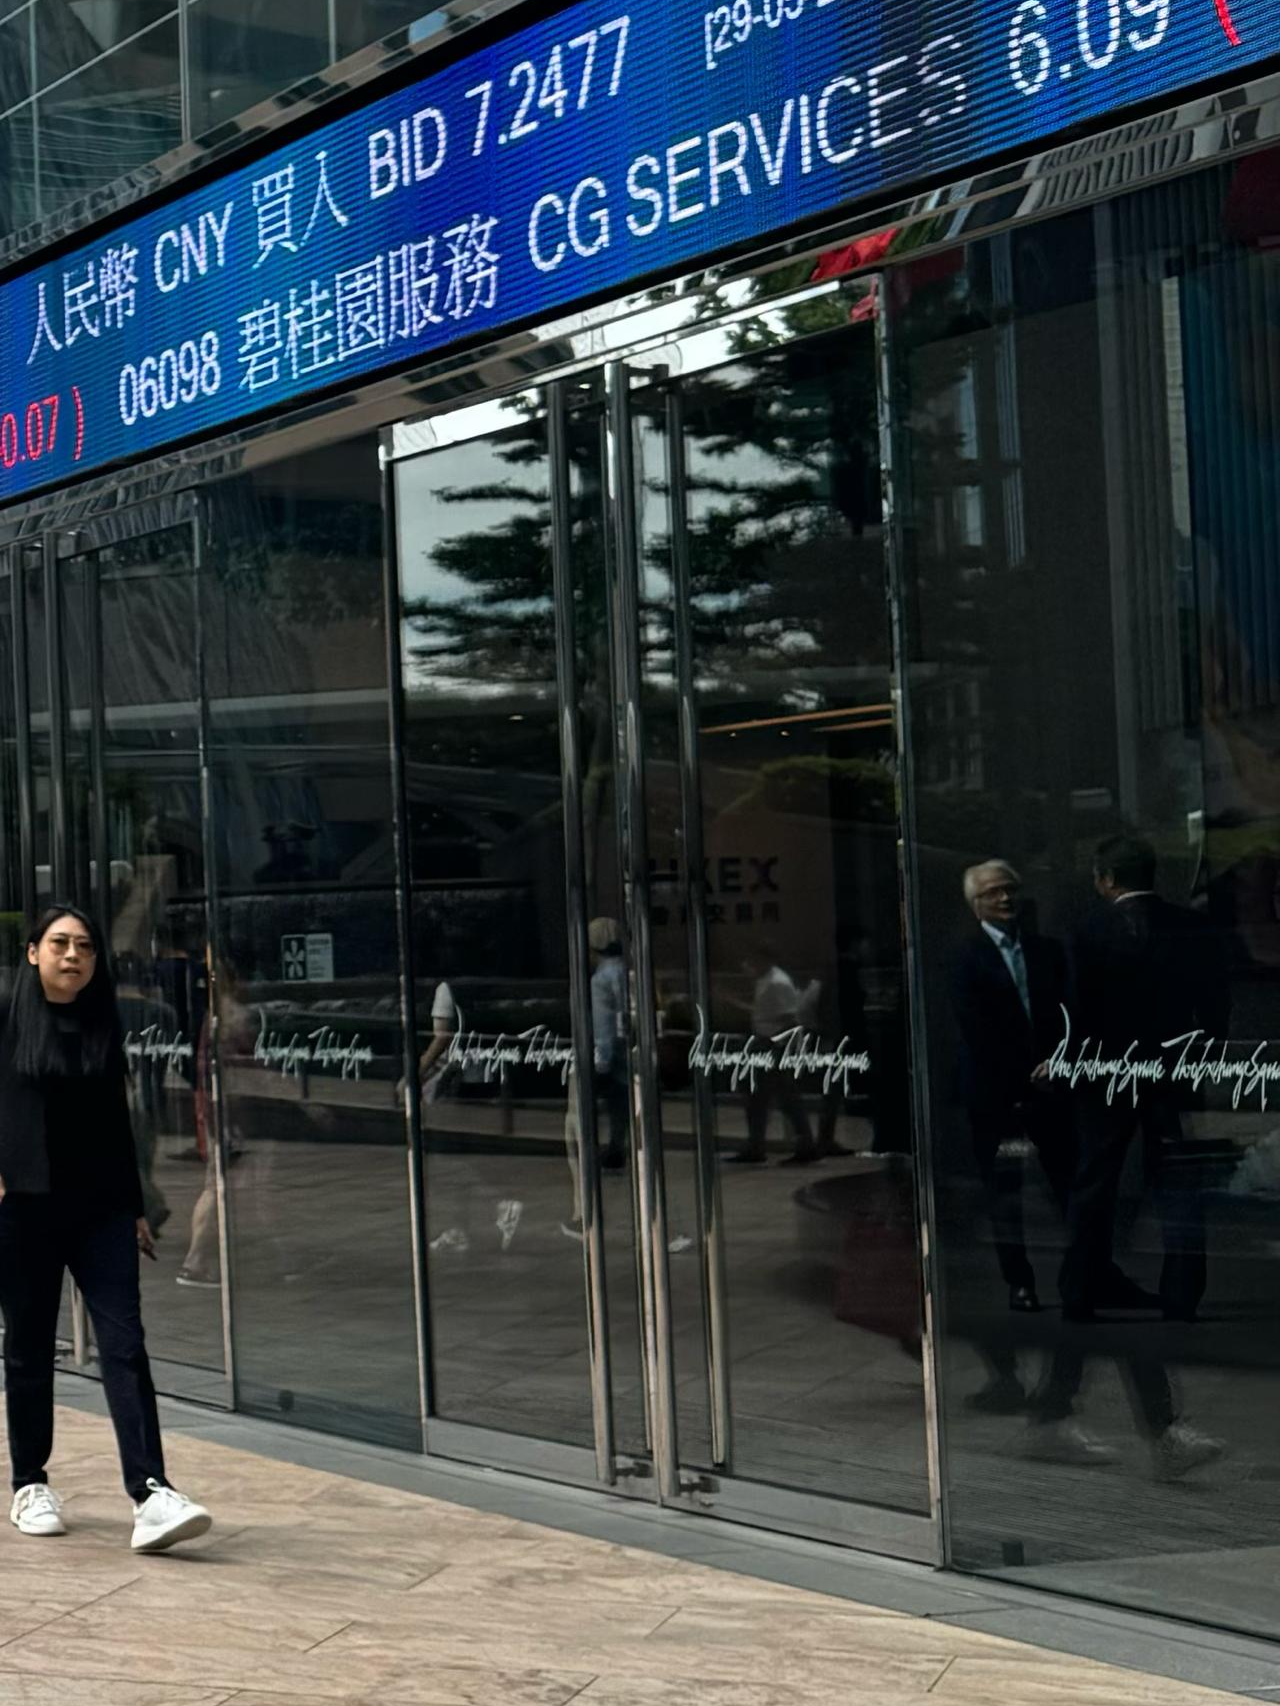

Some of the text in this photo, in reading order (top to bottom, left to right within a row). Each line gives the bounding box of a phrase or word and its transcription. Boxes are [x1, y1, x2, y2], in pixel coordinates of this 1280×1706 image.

[26, 242, 139, 366] 人民幣
[153, 200, 235, 293] CNY
[367, 106, 447, 200] BID
[464, 14, 631, 157] 7.2477
[118, 330, 222, 426] 06098
[236, 212, 501, 394] 碧桂園服務
[528, 175, 611, 272] CG
[625, 34, 967, 237] SERVICES
